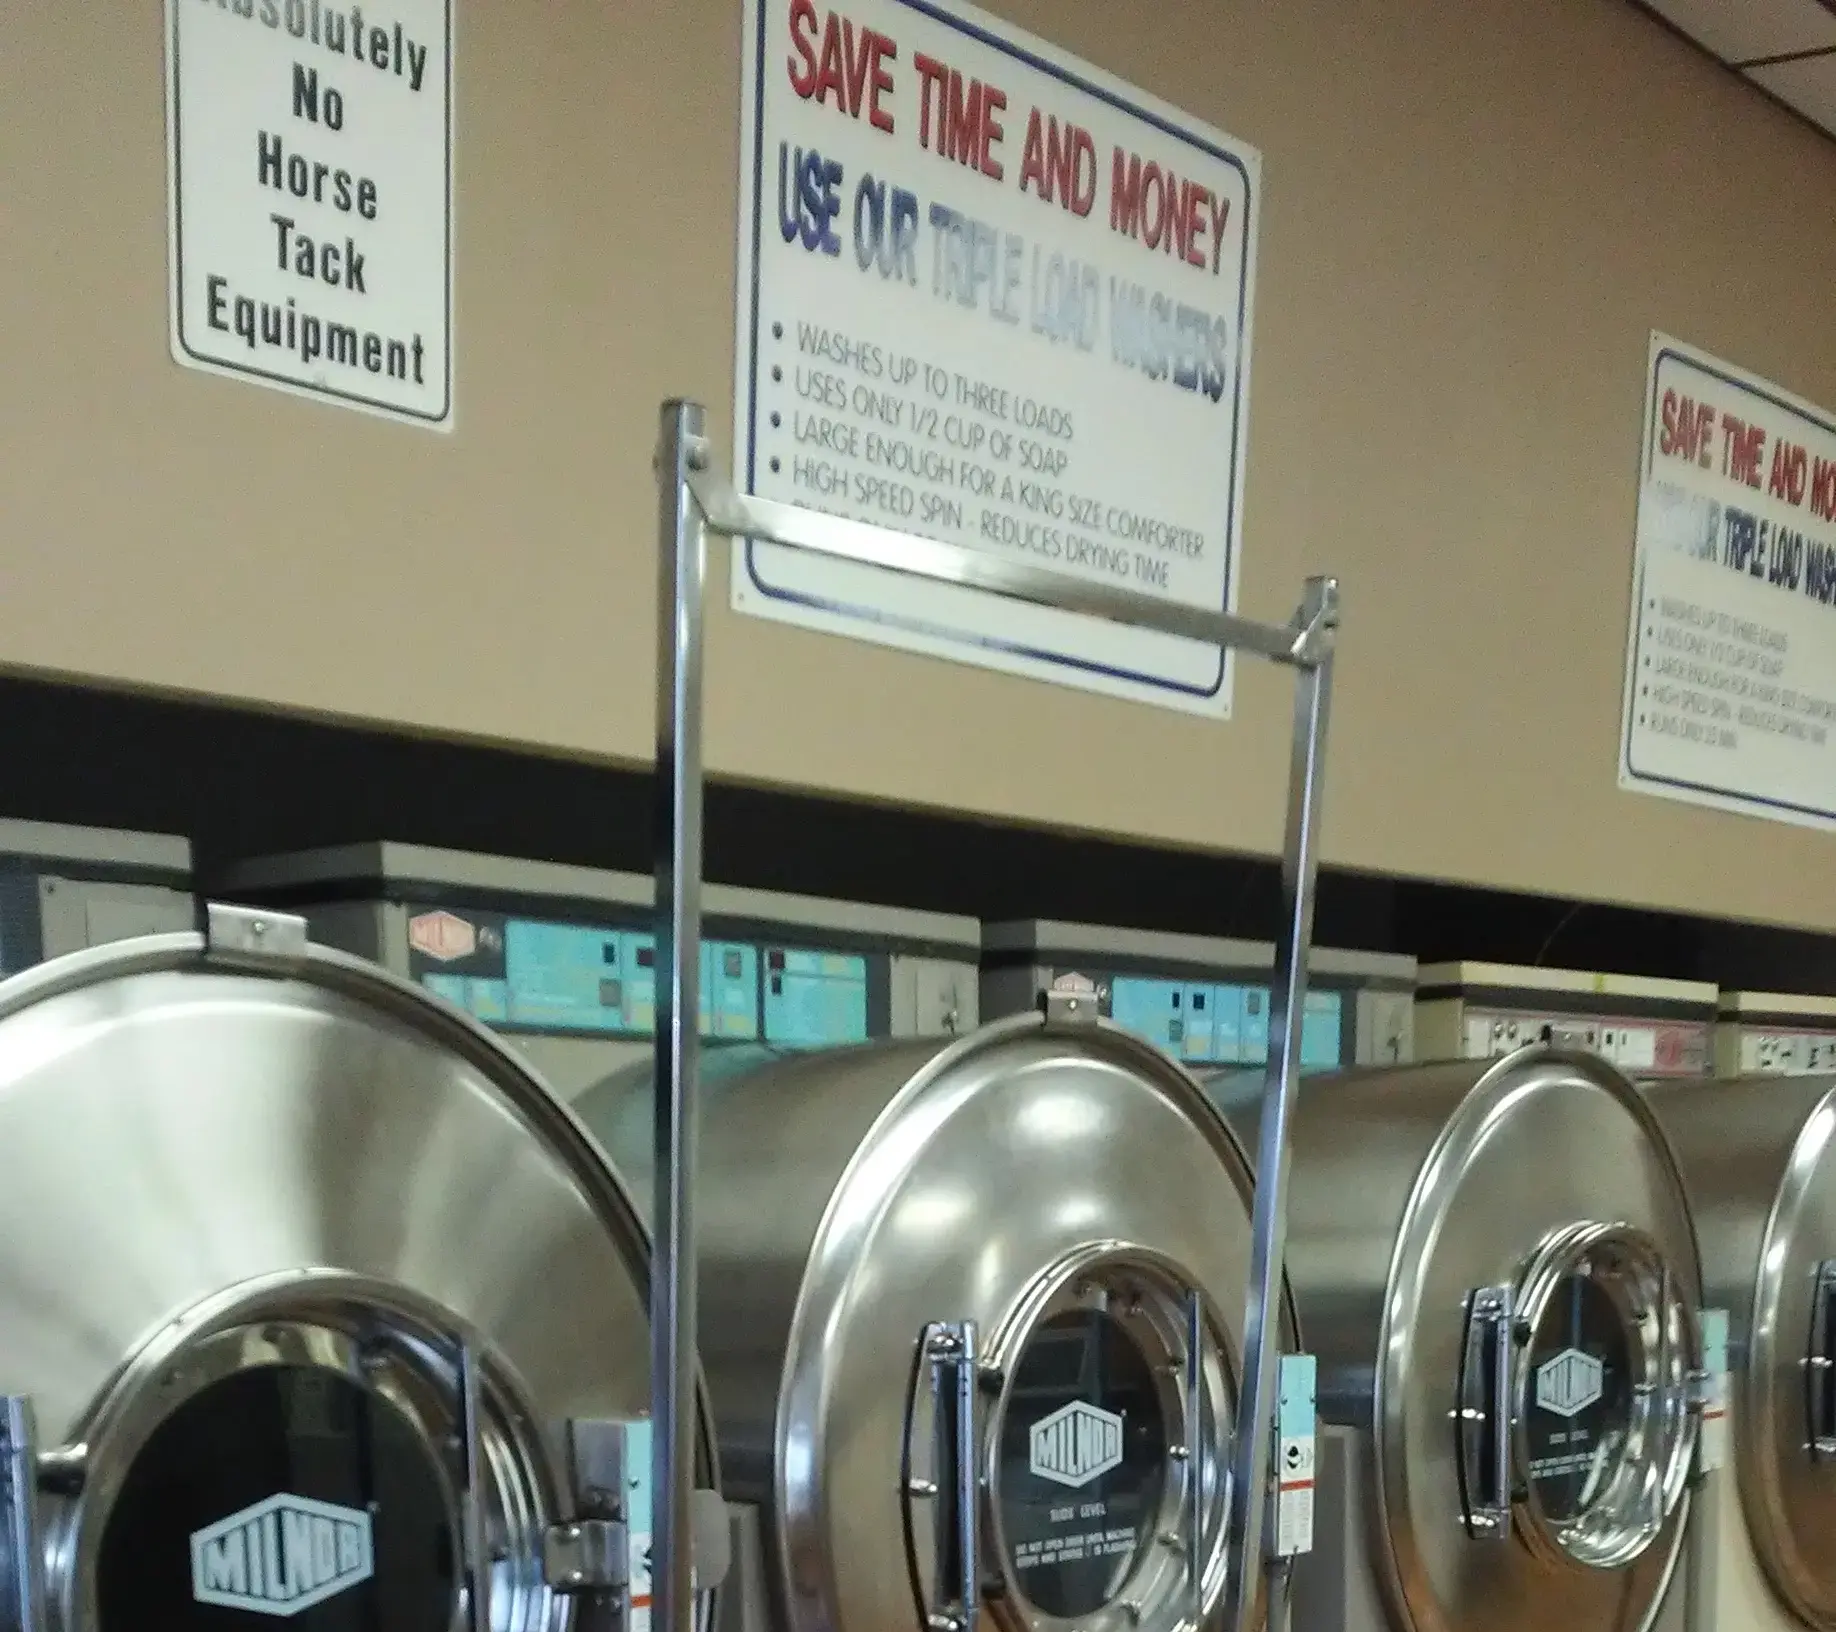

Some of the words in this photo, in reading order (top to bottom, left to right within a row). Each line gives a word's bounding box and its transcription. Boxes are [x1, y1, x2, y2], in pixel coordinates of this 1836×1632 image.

[216, 0, 427, 92] solutely
[292, 61, 343, 131] No
[258, 130, 377, 220] Horse
[787, 0, 897, 134] SAVE
[913, 51, 1007, 182] TIME
[1019, 105, 1097, 218] AND
[1109, 145, 1231, 276] MONEY
[270, 212, 367, 294] Tack
[779, 141, 844, 257] USE
[853, 172, 919, 288] OUR
[929, 201, 1024, 326] TRIPLE
[1031, 242, 1099, 353] LOAD
[207, 273, 425, 386] Equipment
[797, 320, 883, 378] WASHES
[888, 351, 917, 386] UP
[922, 361, 949, 398] TO
[953, 373, 1010, 422] THREE
[1014, 393, 1073, 440] LOADS
[795, 366, 847, 412] USES
[851, 382, 906, 428] ONLY
[909, 400, 939, 438] 1/2
[943, 410, 986, 449] CUP
[988, 425, 1012, 460] OF
[1018, 439, 1069, 479] SOAP
[1660, 387, 1717, 469] SAVE
[1722, 412, 1766, 491] TIME
[1768, 437, 1807, 506] AND
[792, 455, 849, 498] HIGH
[853, 470, 914, 518] SPEED
[919, 488, 963, 530] SPIN
[979, 511, 1063, 558] REDUCES
[1065, 534, 1131, 579] DRYING
[1134, 552, 1170, 588] TIME
[793, 410, 859, 459] LARGE
[864, 431, 955, 487] ENOUGH
[959, 463, 996, 500] FOR
[999, 476, 1014, 501] A
[1018, 478, 1064, 519] KING
[1068, 493, 1102, 528] SIZE
[1105, 505, 1205, 558] COMFORTER
[1035, 1411, 1117, 1477] MILNOR
[200, 1506, 362, 1601] MILNOR
